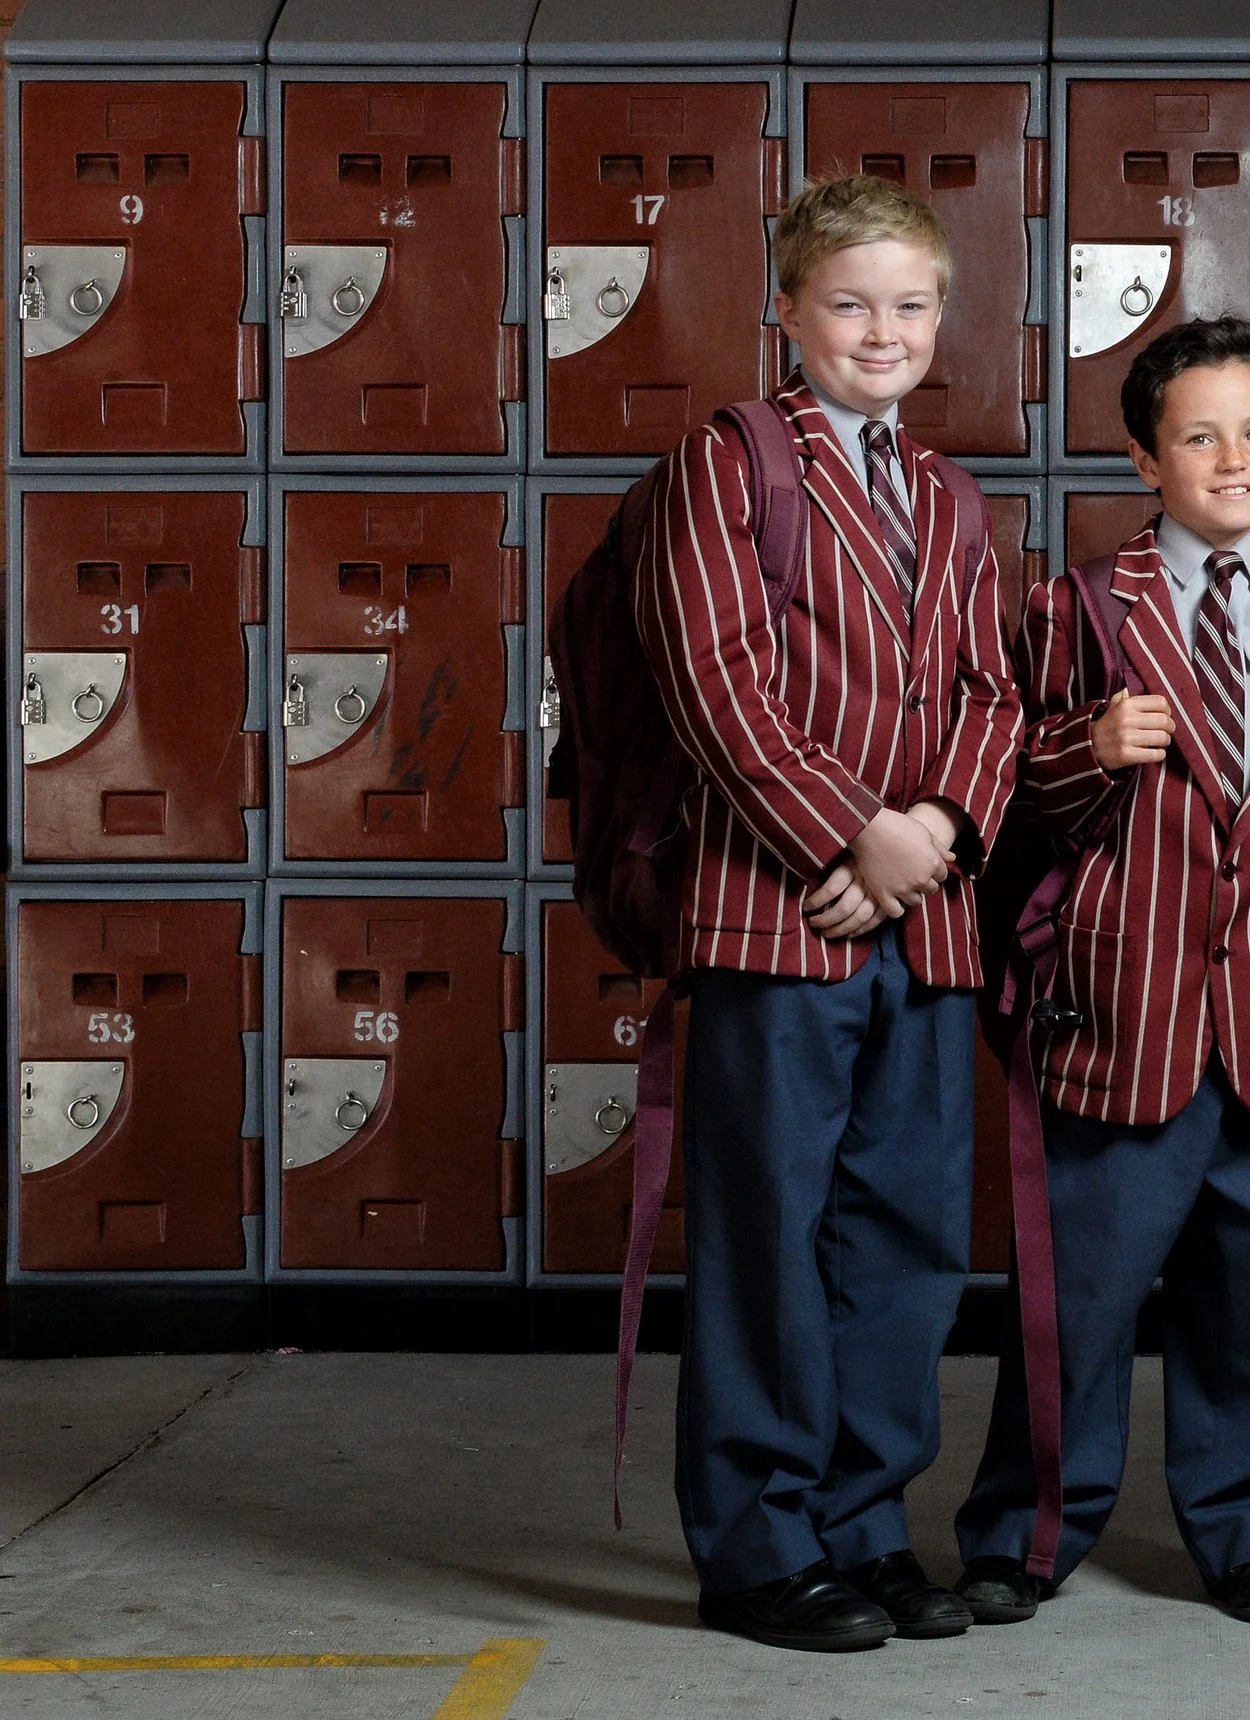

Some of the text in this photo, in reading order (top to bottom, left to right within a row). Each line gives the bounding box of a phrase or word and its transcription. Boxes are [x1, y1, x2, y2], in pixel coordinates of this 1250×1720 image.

[119, 194, 144, 225] 9
[630, 194, 666, 225] 17
[1157, 195, 1196, 227] 18
[101, 604, 139, 635] 31
[363, 605, 409, 636] 34
[87, 1012, 136, 1044] 53
[354, 1010, 400, 1045] 56
[613, 1015, 650, 1046] 6
